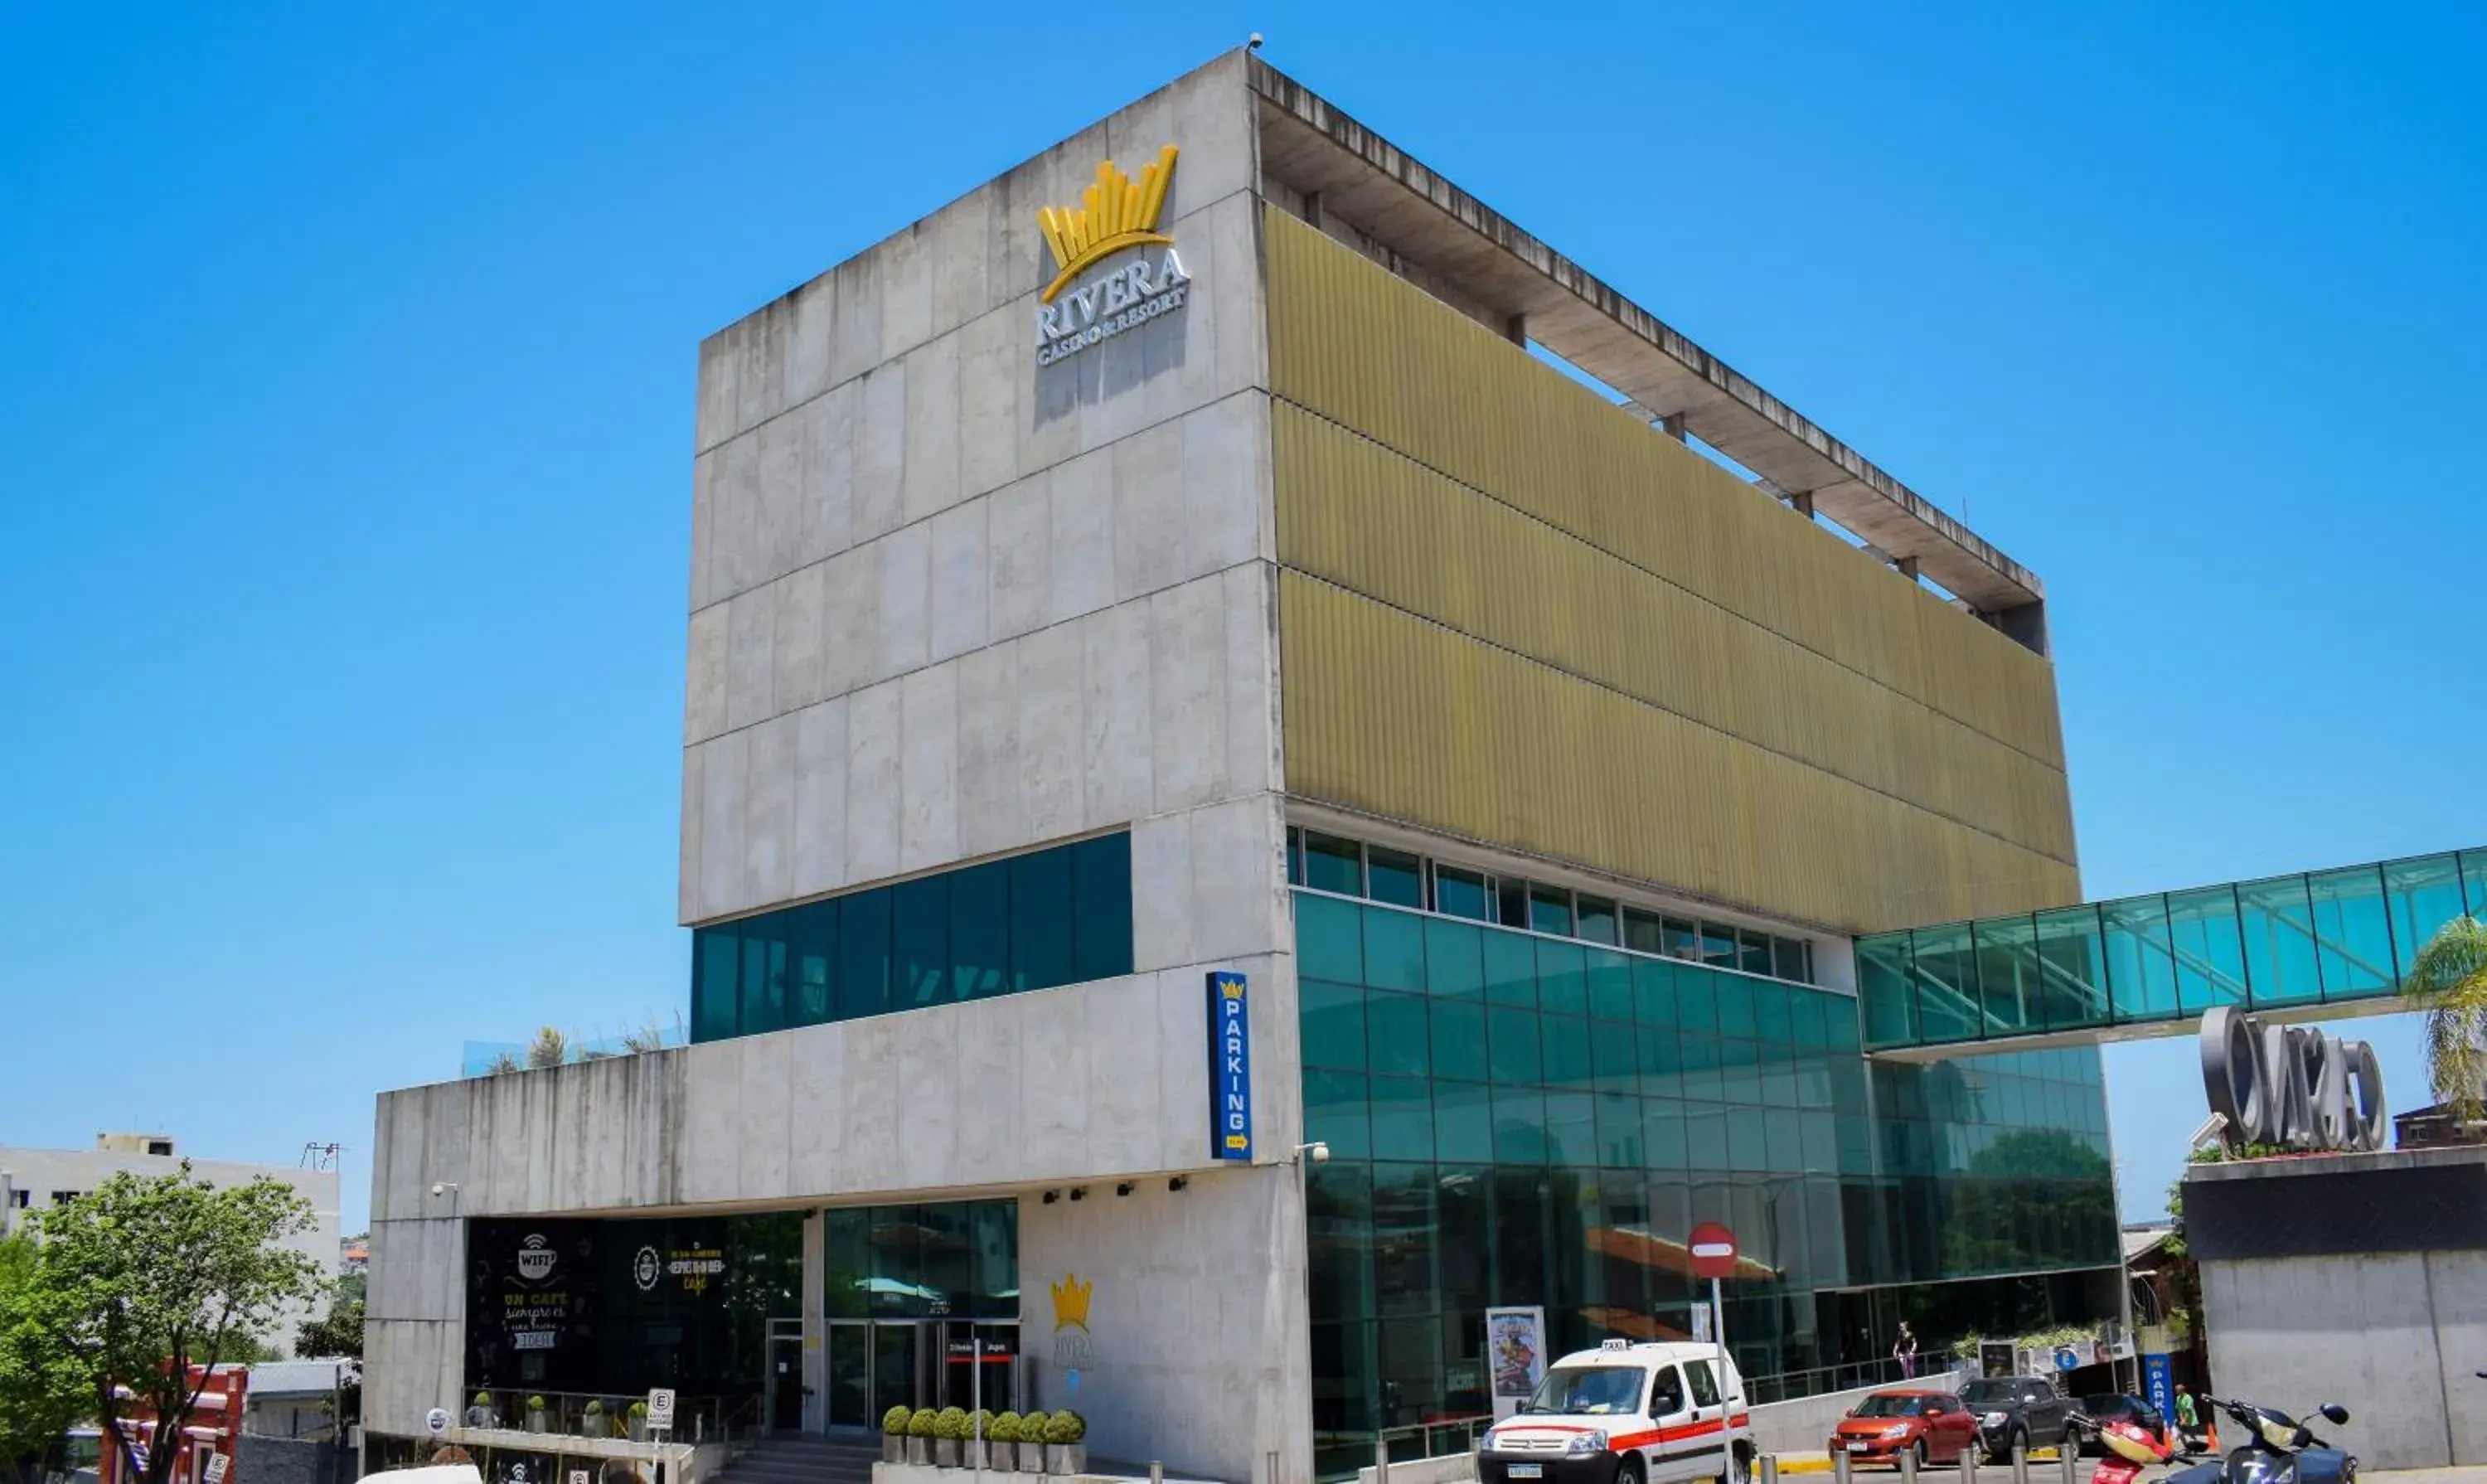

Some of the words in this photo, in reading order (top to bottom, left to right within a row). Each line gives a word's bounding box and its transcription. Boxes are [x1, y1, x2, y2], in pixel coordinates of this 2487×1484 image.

[1036, 248, 1190, 346] RIVERA
[1225, 1000, 1244, 1130] PARKING
[521, 1254, 550, 1267] WIFI
[1604, 1341, 1623, 1351] TAXI
[656, 1395, 666, 1407] E
